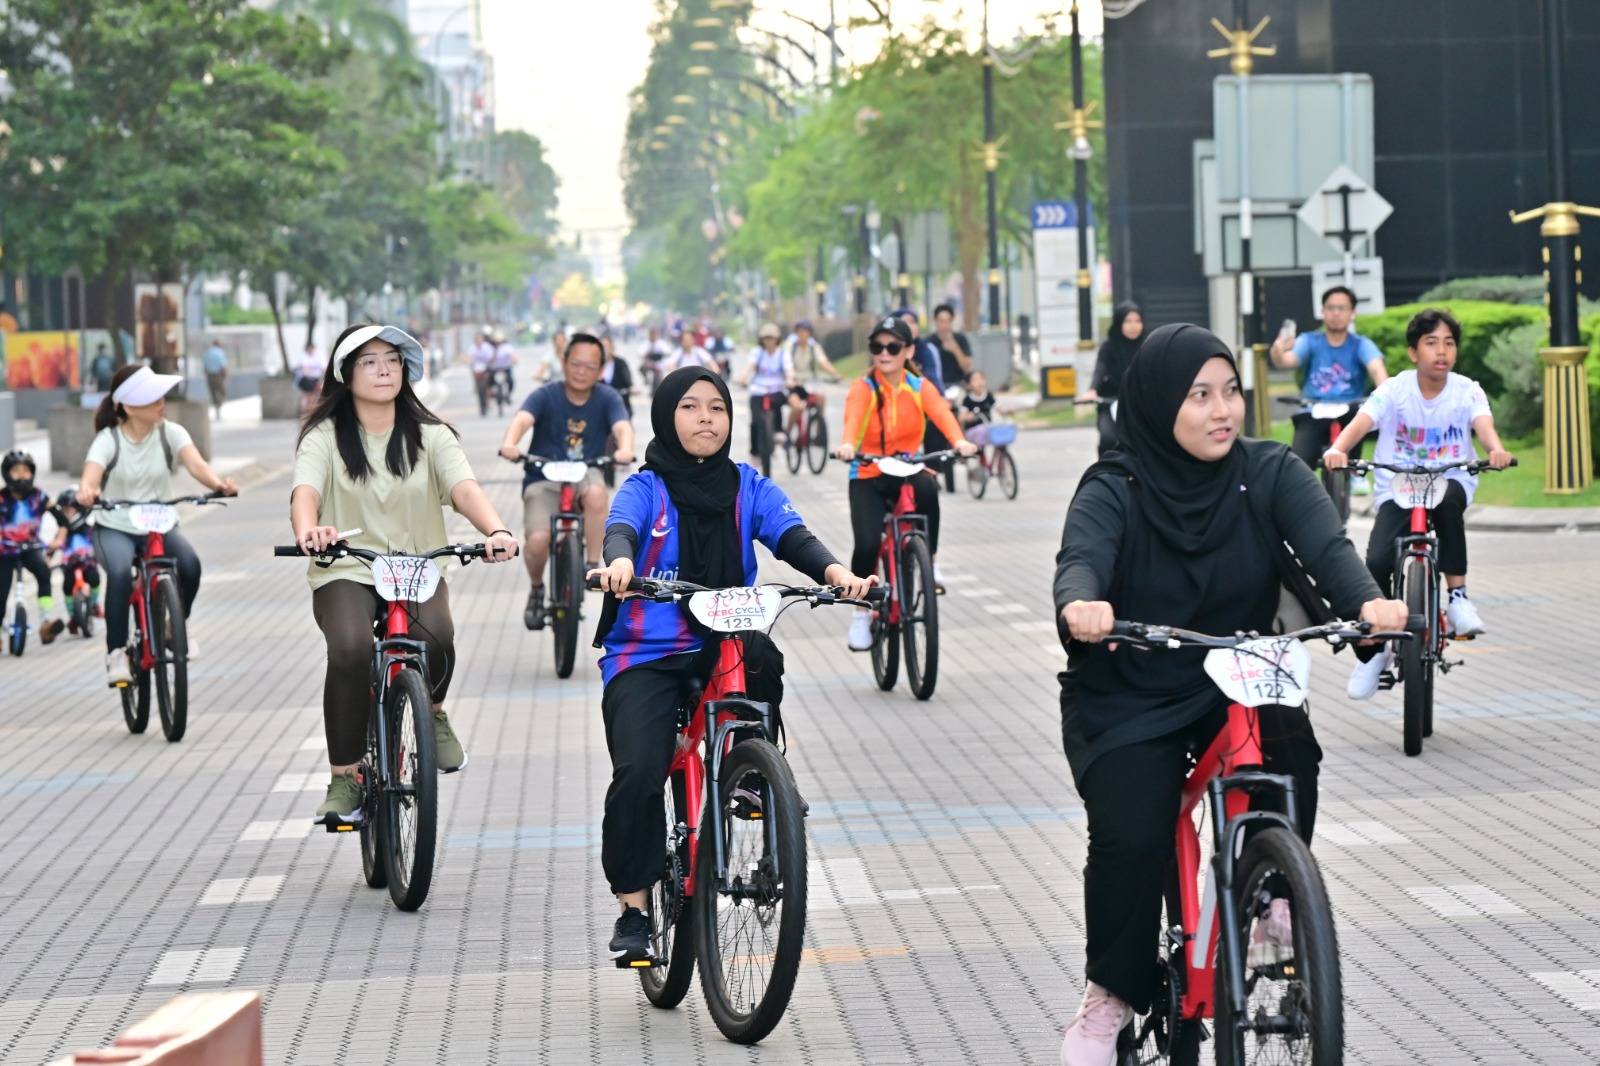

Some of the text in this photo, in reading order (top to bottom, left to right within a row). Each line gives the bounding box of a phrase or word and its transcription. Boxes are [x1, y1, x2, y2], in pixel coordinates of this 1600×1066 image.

[707, 606, 767, 618] OCBC CYCLE
[724, 617, 753, 629] 123
[1254, 683, 1286, 699] 122
